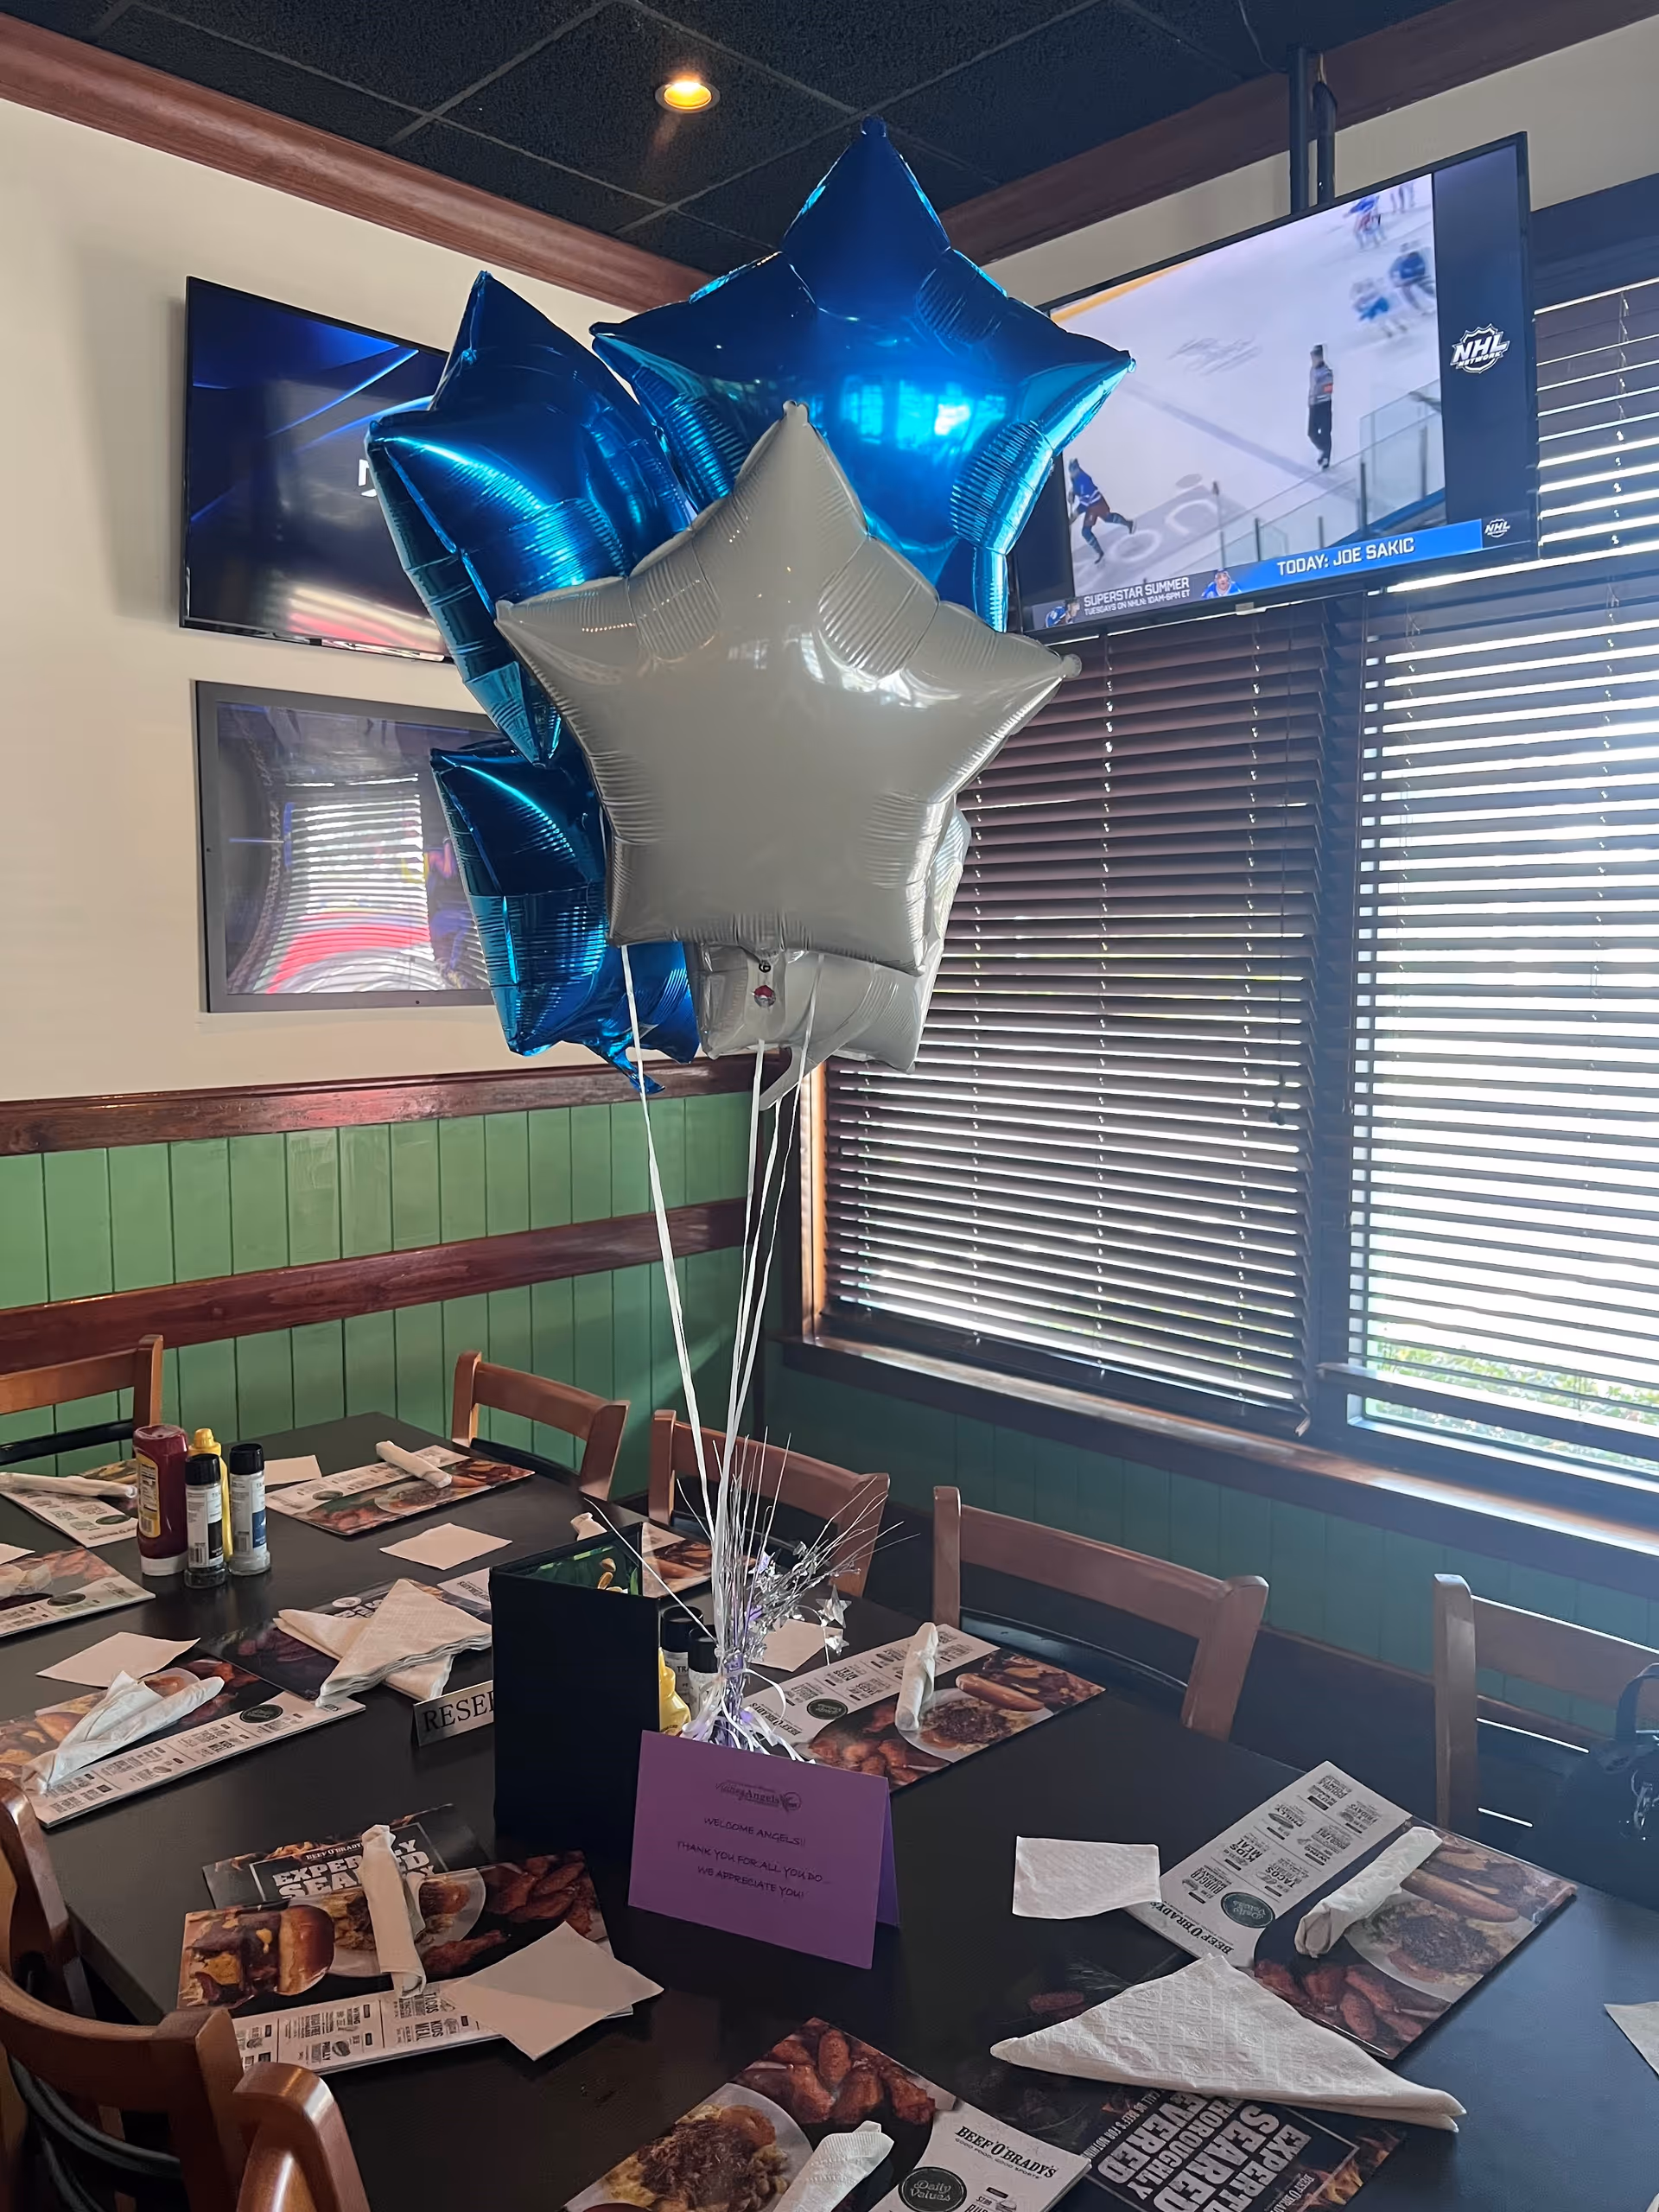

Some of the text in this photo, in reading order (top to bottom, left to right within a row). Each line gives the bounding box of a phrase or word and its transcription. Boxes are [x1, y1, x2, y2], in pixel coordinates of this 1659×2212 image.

[1452, 333, 1509, 364] NHL
[1458, 351, 1502, 367] NETWORK
[1484, 521, 1510, 534] NHL
[1277, 537, 1415, 575] TODAY: JOE SAKIC
[1084, 576, 1190, 607] SUPERSTAR SUMMER
[1084, 602, 1116, 616] TUESDAYS
[1117, 601, 1128, 610] ON
[1182, 589, 1190, 598] ET
[704, 1817, 754, 1834] WELCOME
[1230, 1844, 1255, 1862] KIDS
[1237, 1838, 1262, 1858] MEAL
[677, 1840, 711, 1856] THANK
[714, 1849, 735, 1863] YOU
[737, 1855, 759, 1866] FOR
[759, 1861, 781, 1872] ALL
[784, 1866, 805, 1879] YOU
[698, 1866, 714, 1876] WE
[716, 1871, 776, 1891] APPRECIATE
[1191, 1870, 1224, 1894] BURGER
[1265, 1866, 1295, 1888] TACOS
[424, 1993, 439, 2014] TACOS
[415, 2022, 431, 2041] MEAL
[430, 2020, 443, 2037] KIDS
[1134, 2101, 1148, 2113] US
[1116, 2109, 1140, 2130] BEEF'S
[1098, 2092, 1208, 2183] EVERED
[1104, 2126, 1122, 2140] FOR
[1082, 2136, 1110, 2159] NOTHIN
[1154, 2105, 1279, 2212] SEARED
[910, 2188, 950, 2202] Values
[914, 2180, 951, 2194] Daily
